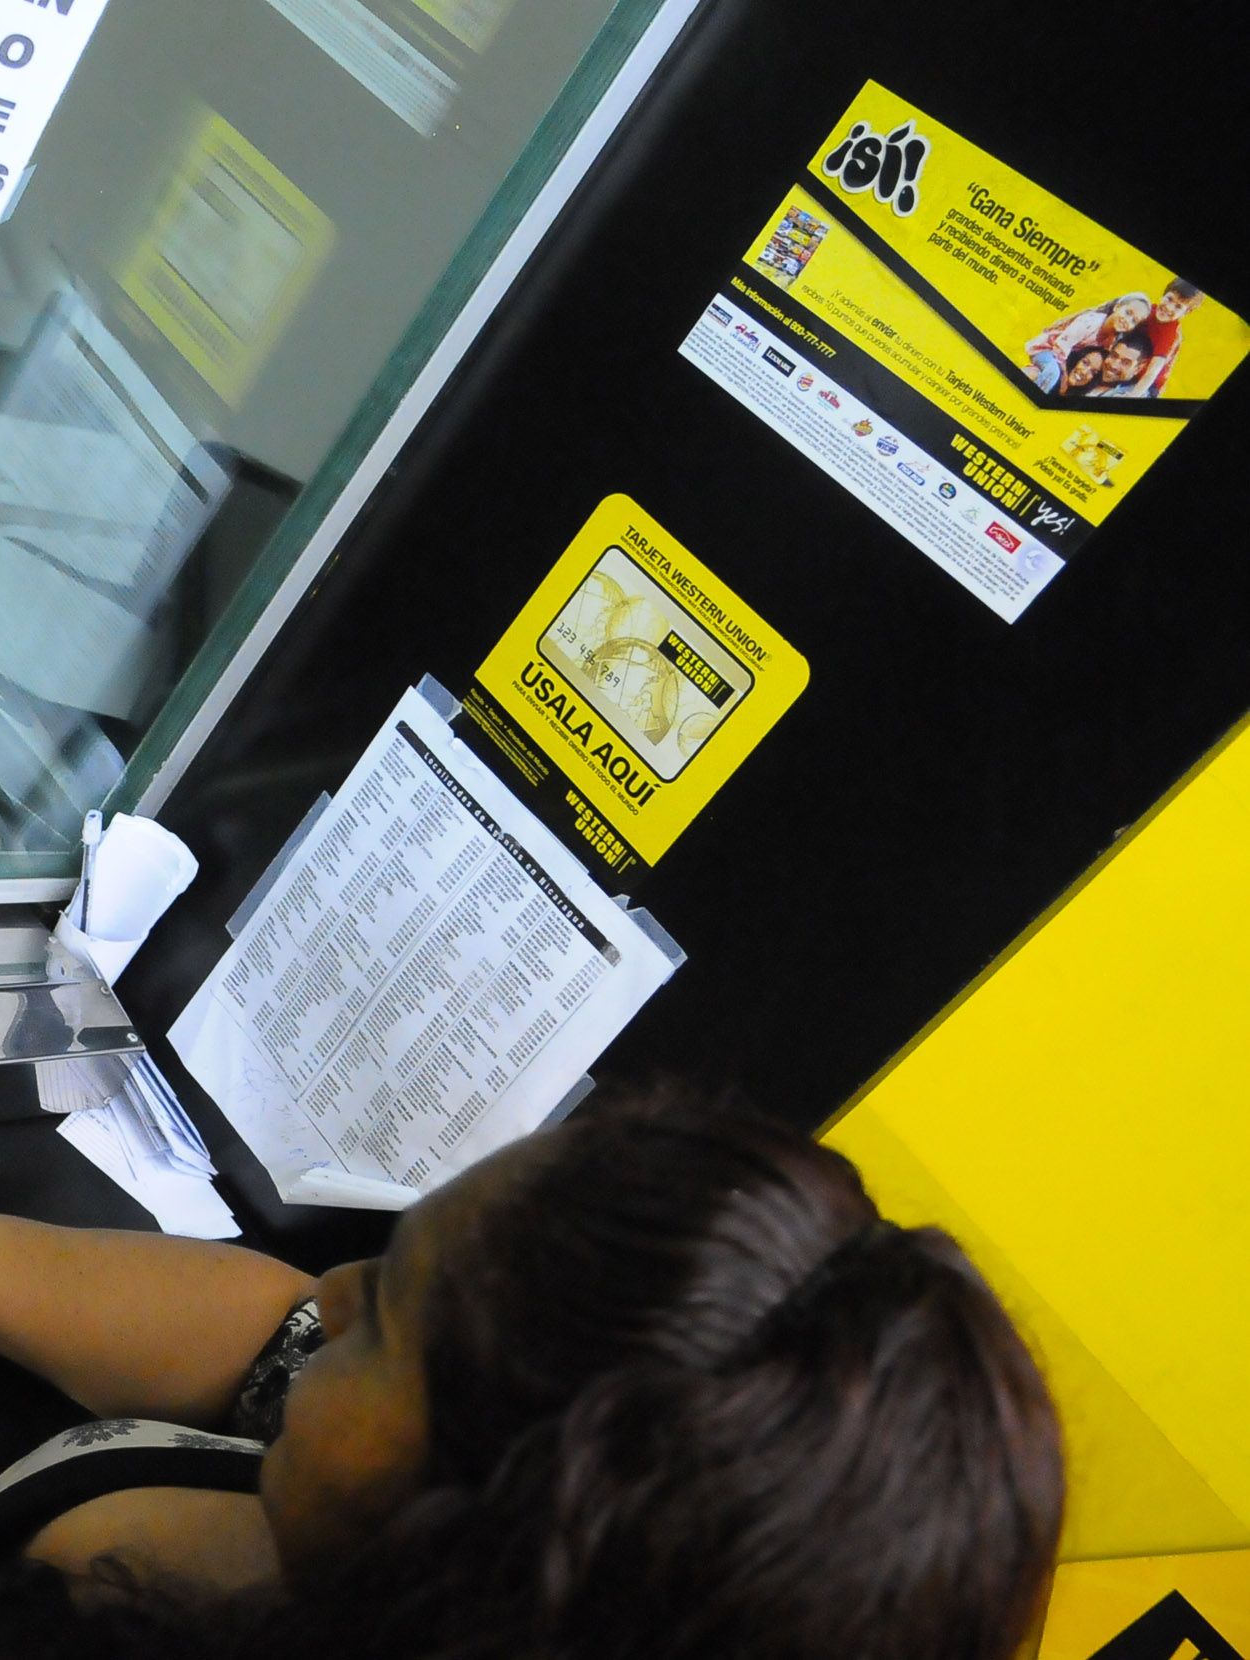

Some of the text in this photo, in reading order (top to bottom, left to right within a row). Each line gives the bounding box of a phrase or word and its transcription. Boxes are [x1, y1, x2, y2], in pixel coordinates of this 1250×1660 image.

[927, 232, 998, 285] parte del mundo.
[936, 220, 1069, 312] y recibiendo dinero a cualquier
[946, 208, 1075, 298] grandes descuentos enviando
[730, 276, 747, 292] Más
[745, 288, 784, 320] información
[782, 317, 792, 326] al
[789, 321, 836, 358] 800-777-7777
[830, 307, 855, 327] puntos
[853, 323, 868, 336] que
[866, 333, 892, 354] puedes
[890, 351, 922, 376] acumular
[948, 394, 963, 407] por
[870, 318, 897, 339] enviar
[894, 335, 904, 346] tu
[902, 342, 924, 361] dinero
[922, 357, 938, 371] con
[935, 365, 945, 376] tu
[945, 369, 973, 396] Tarjeta
[972, 390, 1006, 420] Western
[951, 434, 1026, 496] WESTERN
[963, 462, 1017, 507] UNION
[1033, 499, 1075, 535] yes!
[625, 525, 672, 574] TARJETA
[671, 569, 726, 624] WESTERN
[556, 622, 620, 688] 123 456 789
[668, 634, 718, 684] WESTERN
[676, 656, 712, 692] UNION
[511, 680, 526, 697] PARA
[525, 694, 545, 716] ENVIAR
[568, 740, 589, 762] DINERO
[617, 792, 639, 816] MUNDO
[520, 662, 660, 806] ÚSALA AQUÍ
[420, 752, 472, 808] Localidades
[474, 809, 486, 822] de
[525, 863, 537, 876] en
[536, 876, 584, 929] Nicaragua
[566, 790, 624, 855] WESTERN
[574, 817, 616, 864] UNION
